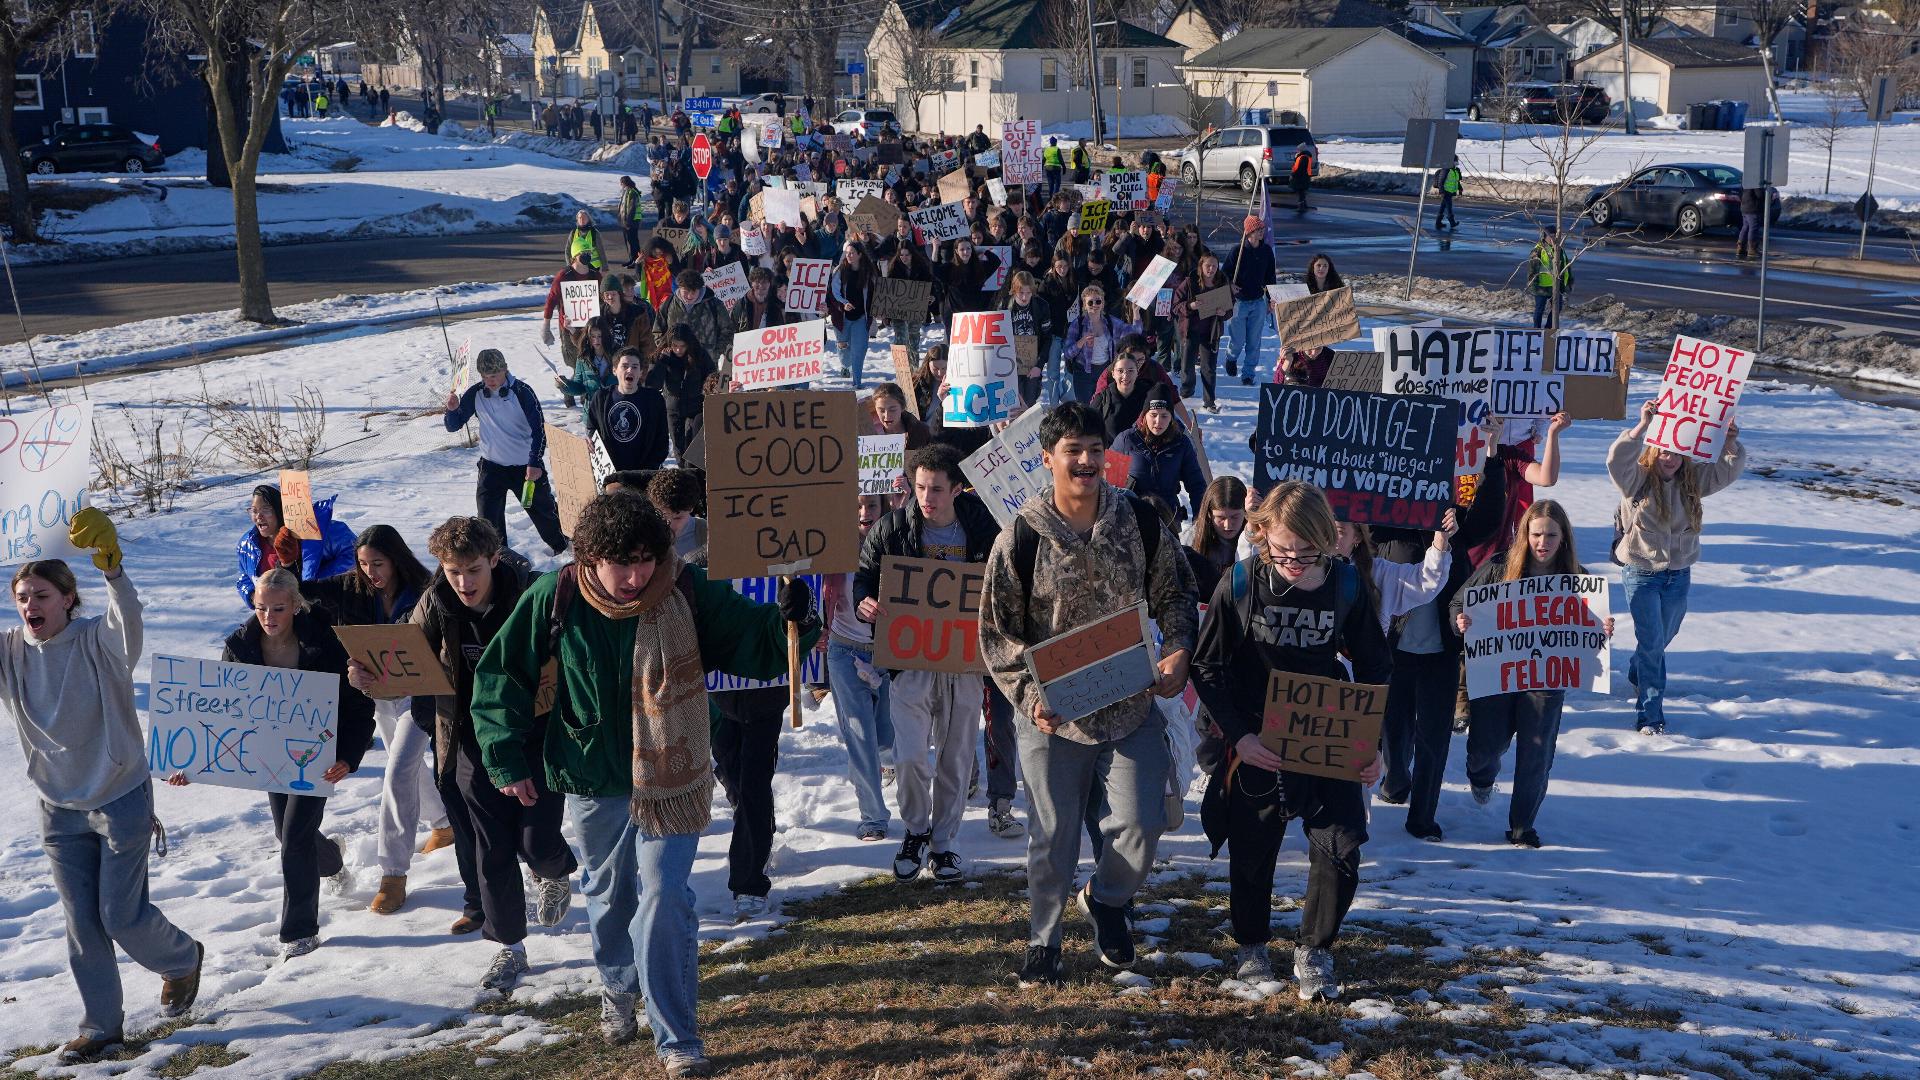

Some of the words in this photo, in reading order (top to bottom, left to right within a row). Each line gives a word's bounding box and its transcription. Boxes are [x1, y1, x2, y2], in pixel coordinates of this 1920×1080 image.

[686, 100, 691, 109] S
[693, 100, 709, 109] 34th
[712, 100, 721, 109] Av
[1004, 120, 1036, 132] ICE
[1005, 132, 1036, 142] OUT
[693, 148, 710, 164] STOP
[1004, 148, 1041, 162] MPLS
[1010, 140, 1032, 150] OF
[838, 180, 854, 188] THE
[857, 180, 884, 188] WRONG
[849, 189, 875, 200] ICE
[1110, 184, 1118, 192] IS
[1116, 191, 1132, 200] ON
[910, 204, 959, 225] WELCOME
[1085, 202, 1107, 216] ICE
[1110, 200, 1129, 210] OLEN
[656, 228, 683, 238] STOP
[921, 224, 958, 240] PANEM
[1082, 217, 1106, 230] OUT
[710, 276, 736, 289] NGRY
[792, 262, 831, 288] ICE
[565, 284, 597, 298] ABOLISH
[788, 288, 827, 312] OUT
[570, 300, 592, 321] ICE
[762, 326, 798, 346] OUR
[952, 313, 1008, 345] LOVE
[734, 340, 821, 366] CLASSMATES
[1390, 330, 1492, 376] HATE
[1554, 336, 1613, 373] OUR
[1672, 338, 1744, 374] HOT
[734, 368, 764, 384] LIVE
[768, 366, 786, 382] IN
[788, 360, 820, 380] FEAR
[1394, 372, 1450, 396] doesn't
[1452, 378, 1488, 395] make
[1664, 364, 1742, 400] PEOPLE
[944, 380, 1008, 422] ICE
[1491, 380, 1561, 416] OOLS
[1655, 388, 1735, 421] MELT
[724, 400, 828, 434] RENEE
[1265, 387, 1316, 438] YOU
[1385, 398, 1446, 456] GET
[1646, 412, 1722, 459] ICE
[736, 435, 844, 476] GOOD
[975, 446, 1012, 478] ICE
[1262, 439, 1284, 459] to
[1290, 442, 1328, 466] talk
[1332, 450, 1375, 470] about
[873, 468, 892, 478] MY
[1265, 461, 1328, 488] WHEN
[1331, 468, 1348, 489] U
[1353, 470, 1413, 498] VOTED
[1414, 480, 1450, 501] FOR
[280, 476, 303, 499] LOVE
[724, 494, 788, 518] ICE
[1002, 488, 1027, 515] NOT
[1326, 488, 1438, 528] FELON
[757, 526, 826, 560] BAD
[889, 563, 984, 612] ICE
[1466, 582, 1512, 607] DON'T
[1518, 577, 1554, 596] TALK
[1560, 574, 1605, 594] ABOUT
[1264, 605, 1335, 630] STAR
[1496, 596, 1596, 630] ILLEGAL
[888, 614, 980, 663] OUT
[1251, 616, 1334, 648] WARS
[1464, 636, 1504, 660] WHEN
[1506, 632, 1535, 650] YOU
[1538, 630, 1578, 648] VOTED
[1582, 632, 1607, 650] FOR
[366, 649, 420, 678] ICE
[1530, 648, 1543, 660] A
[157, 656, 188, 686] I
[1500, 656, 1580, 692] FELON
[155, 687, 244, 718] Streets
[1272, 676, 1330, 708] HOT
[1339, 686, 1384, 716] PPL
[1288, 711, 1356, 738] MELT
[150, 725, 197, 772] NO
[200, 724, 258, 774] ICE
[1278, 736, 1350, 768] ICE
